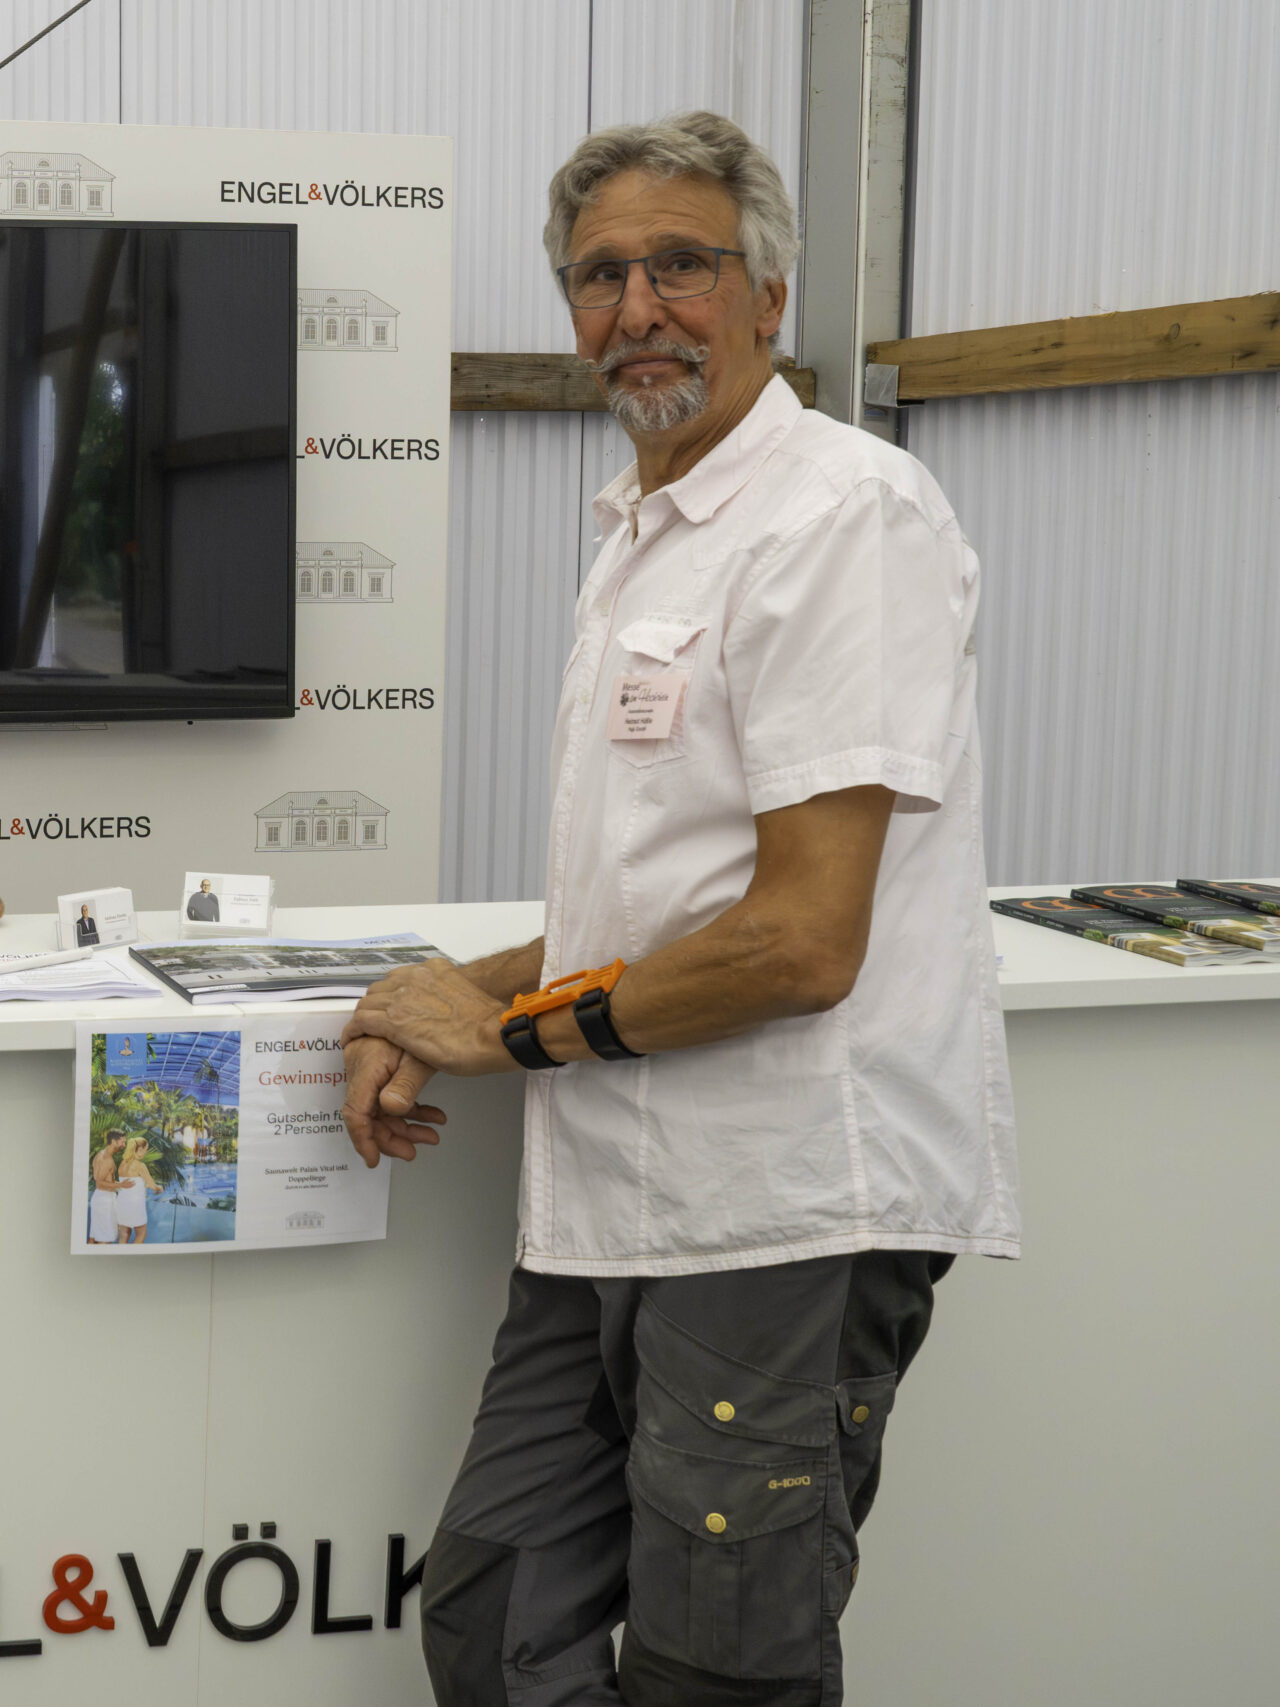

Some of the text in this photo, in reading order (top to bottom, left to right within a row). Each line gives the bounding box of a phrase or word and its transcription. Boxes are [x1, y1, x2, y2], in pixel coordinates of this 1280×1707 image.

[220, 179, 444, 210] ENGEL&VÖLKERS
[295, 684, 435, 711] &VÖLKERS
[255, 1037, 345, 1053] ENGEL&VÖLK
[267, 1111, 331, 1124] Gutschein
[274, 1123, 344, 1136] 2 Personen
